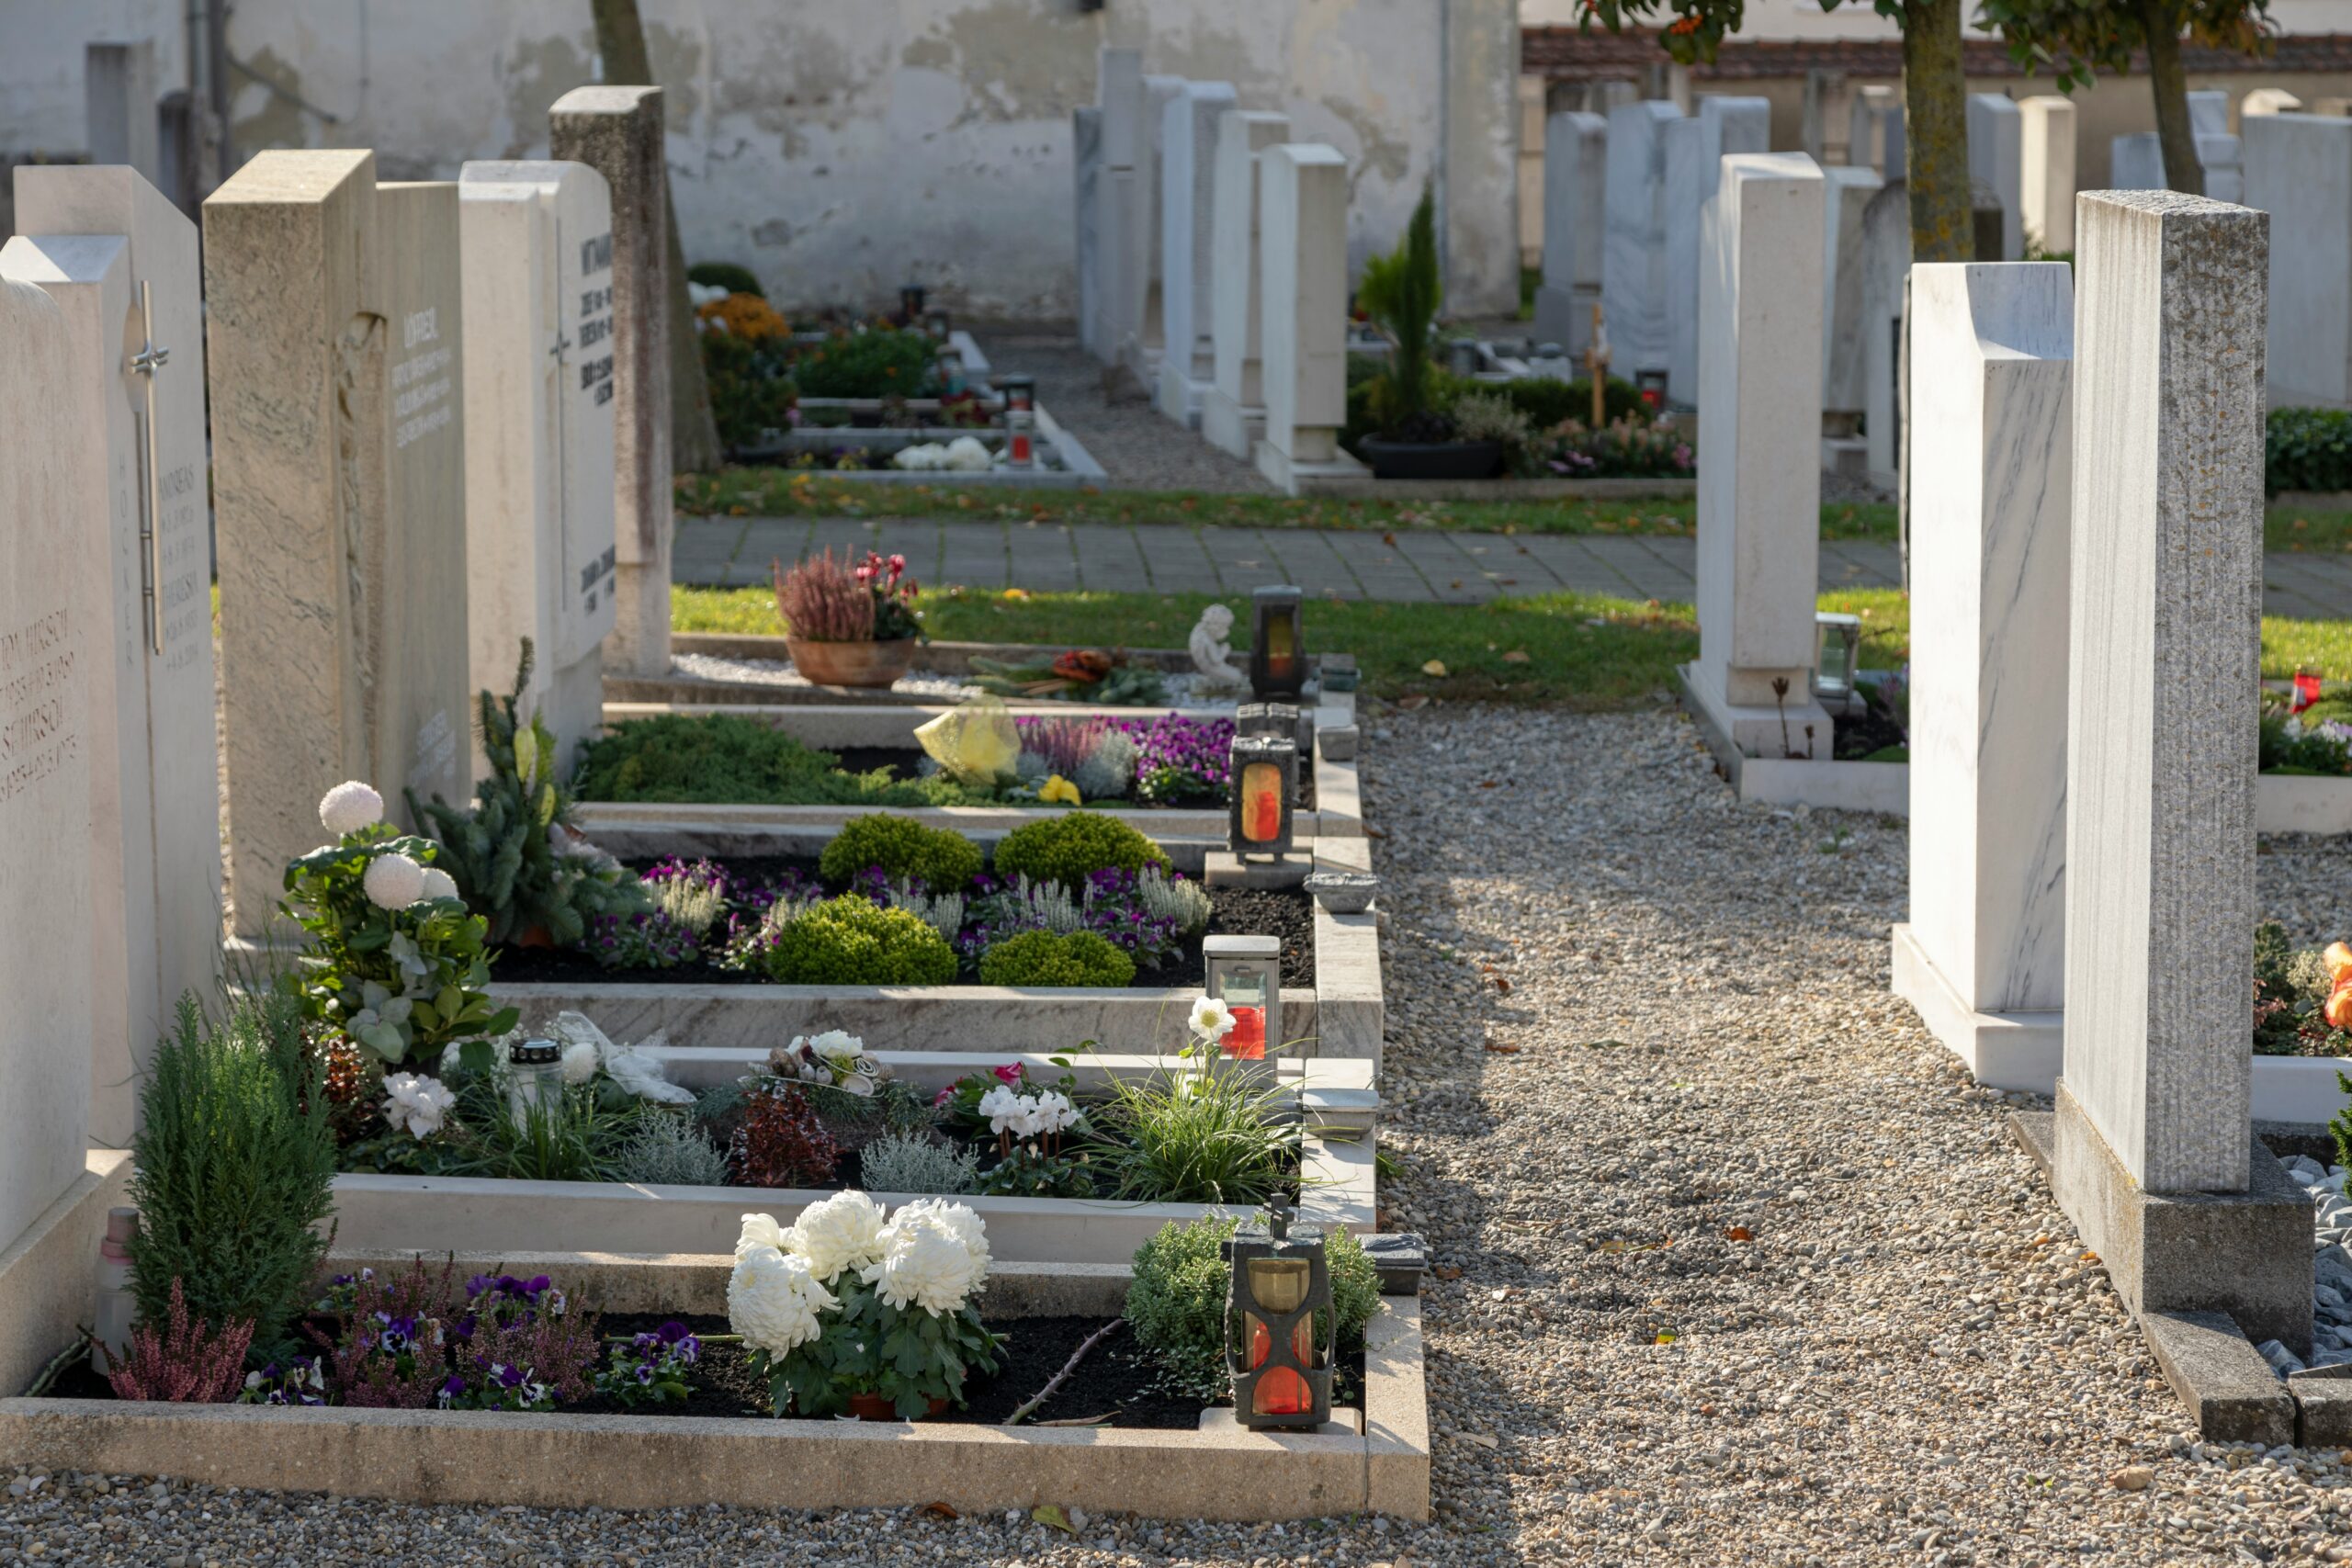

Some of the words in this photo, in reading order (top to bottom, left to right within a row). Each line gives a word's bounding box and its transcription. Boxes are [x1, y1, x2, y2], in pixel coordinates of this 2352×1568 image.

[159, 463, 195, 502] ANDREAS
[162, 570, 198, 610] THERESIA
[27, 607, 67, 657] HIRSCH
[21, 695, 62, 750] HIRSCH
